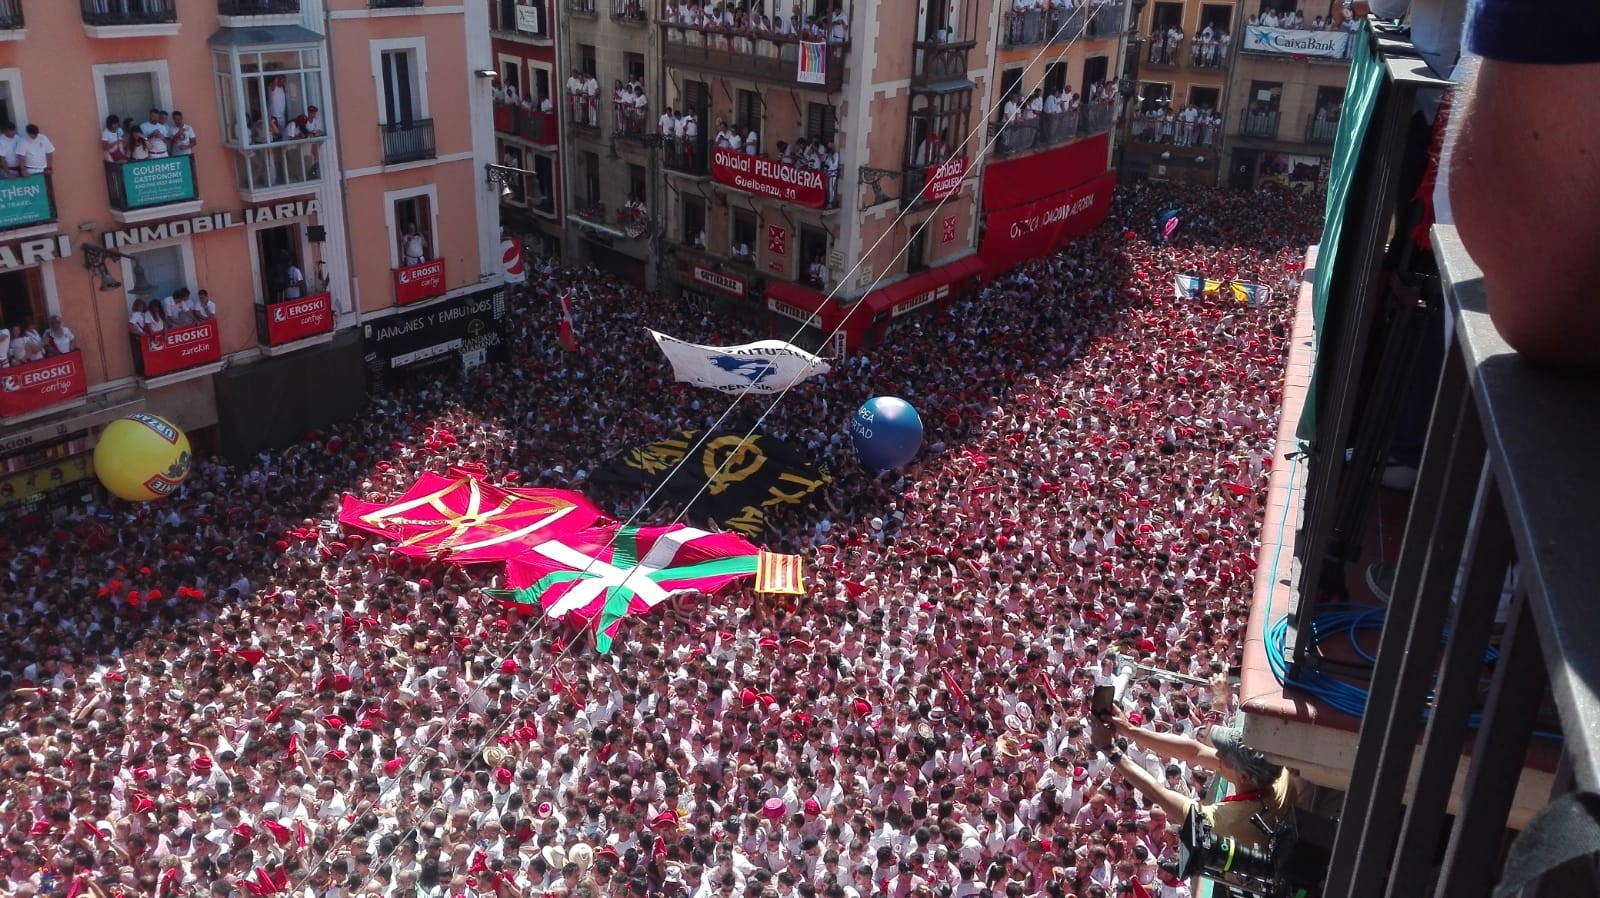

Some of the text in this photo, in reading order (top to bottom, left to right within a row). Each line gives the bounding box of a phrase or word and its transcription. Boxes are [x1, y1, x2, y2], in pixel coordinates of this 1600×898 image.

[1274, 34, 1335, 51] CaixaBank
[132, 161, 181, 176] GOURMET
[715, 151, 823, 190] ohlala! PELUQUERIA
[133, 171, 183, 184] GASTRONOMY
[0, 184, 40, 201] THERN
[104, 200, 325, 249] INMOBILIARIA
[412, 265, 440, 279] EROSKI
[289, 300, 323, 316] EROSKI
[427, 314, 436, 326] Y
[167, 328, 209, 345] EROSKI
[181, 343, 210, 356] zurekin
[24, 364, 71, 385] EROSKI
[41, 381, 71, 394] contigo
[131, 412, 175, 440] URZAN
